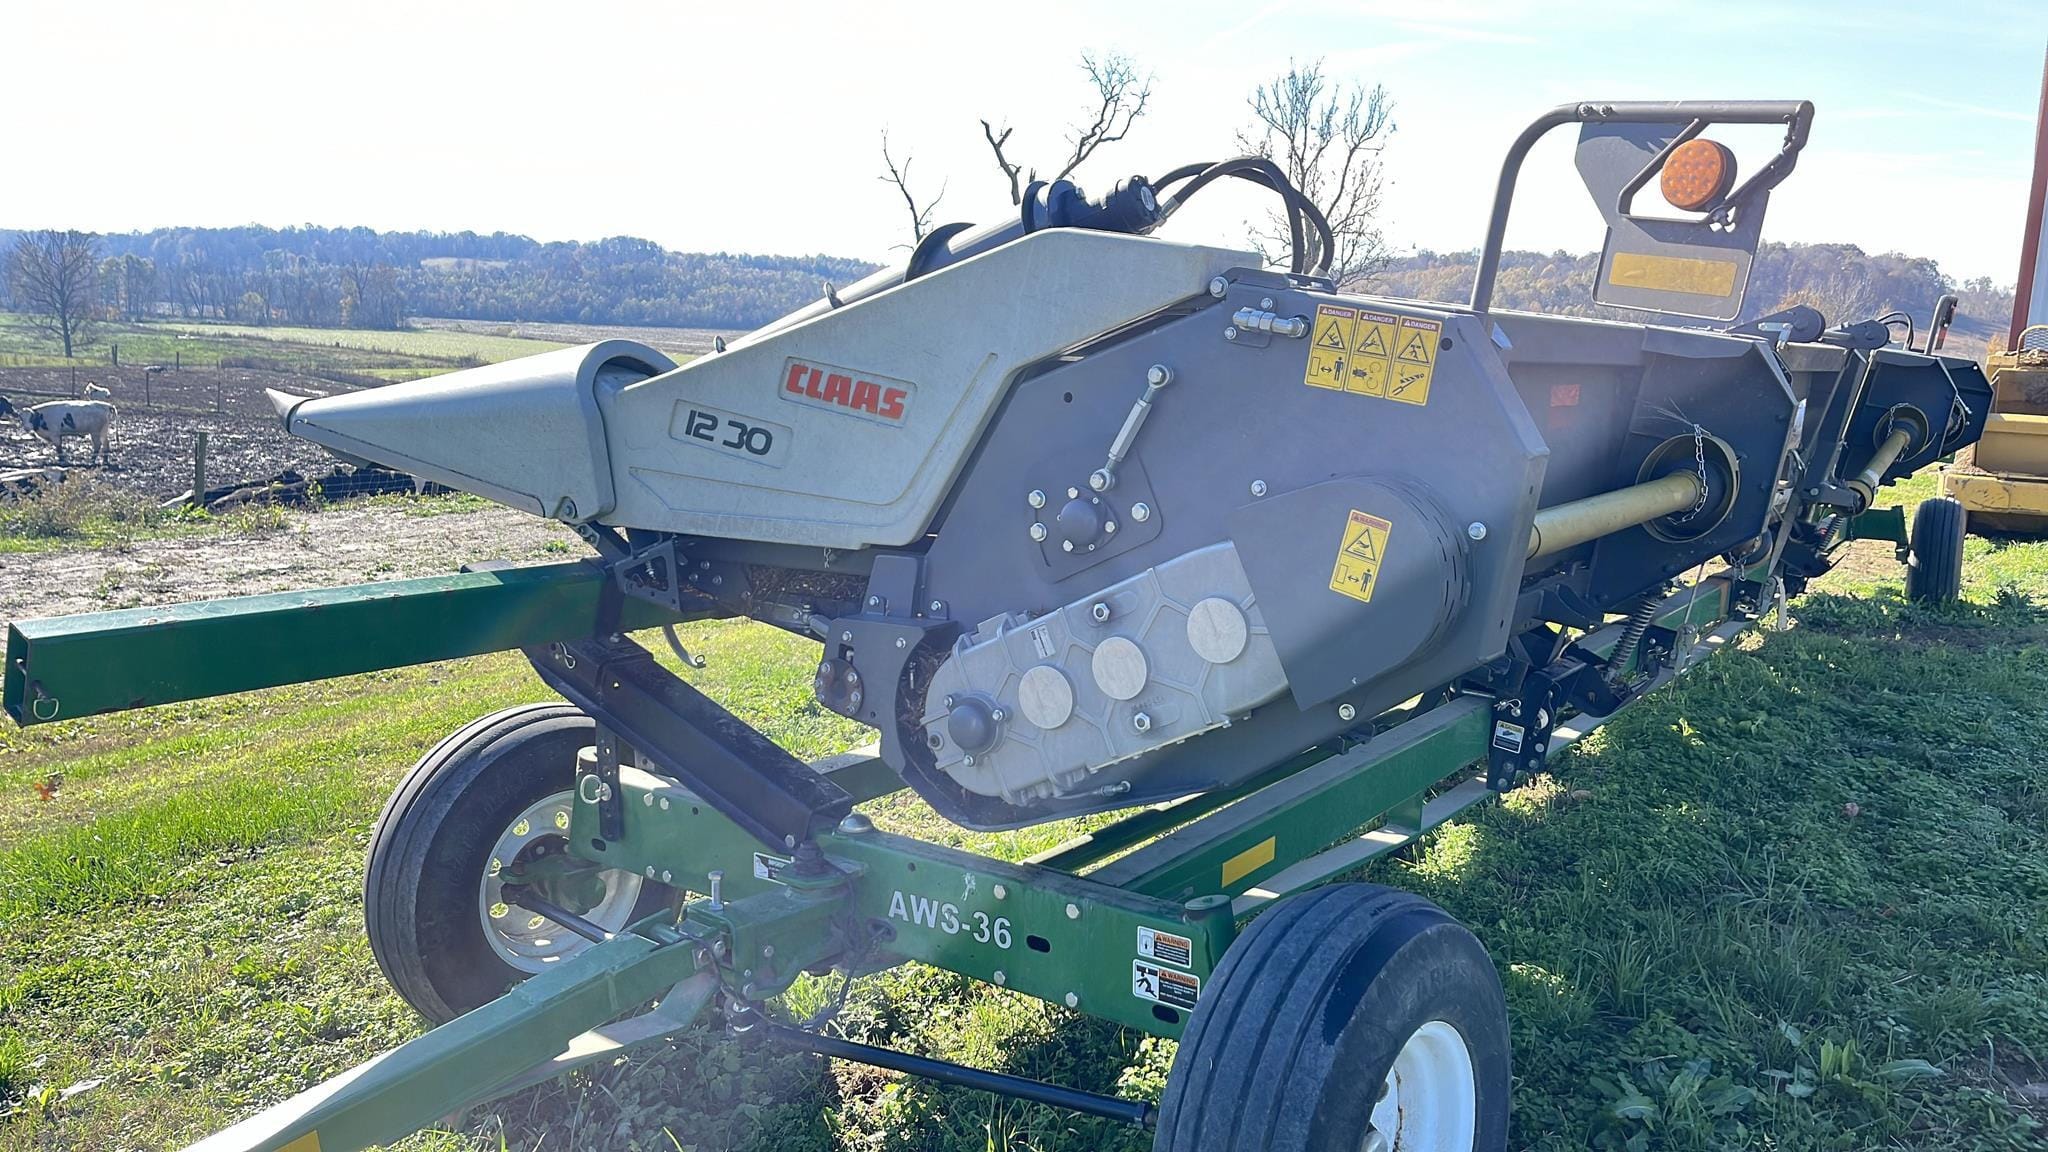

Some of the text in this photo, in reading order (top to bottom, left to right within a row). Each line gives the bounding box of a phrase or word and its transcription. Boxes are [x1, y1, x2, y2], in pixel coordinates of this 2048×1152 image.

[1327, 308, 1352, 318] DANGER
[1368, 314, 1394, 324] DANGER
[1409, 321, 1437, 331] DANGER
[786, 363, 908, 420] CLAAS
[888, 890, 1012, 949] AWS-36
[1162, 935, 1189, 948] WARNING
[1168, 971, 1196, 985] WARNING
